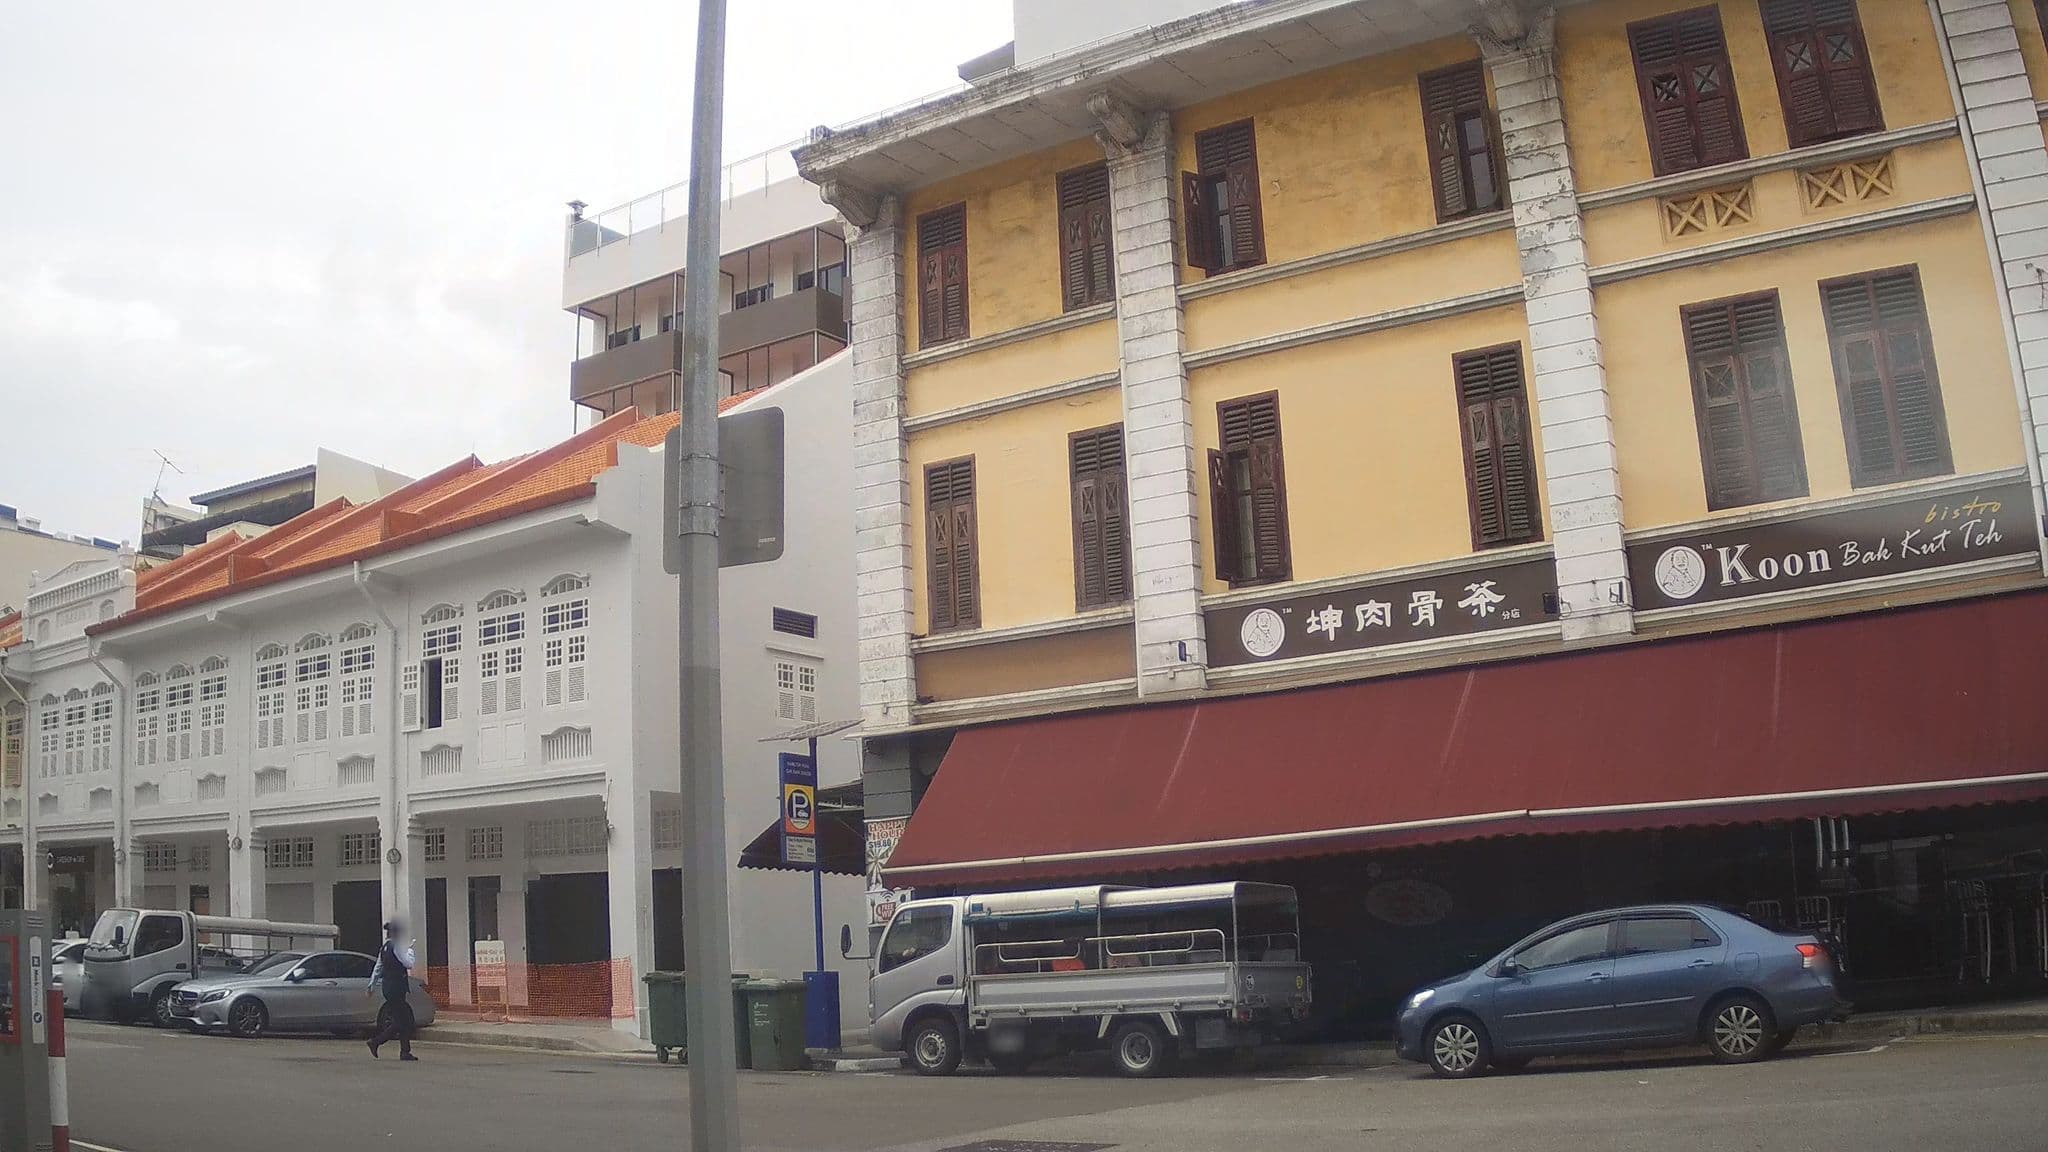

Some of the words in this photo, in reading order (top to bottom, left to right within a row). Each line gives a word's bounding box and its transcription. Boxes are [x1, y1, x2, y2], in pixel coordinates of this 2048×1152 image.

[1924, 496, 2002, 523] bistro
[1716, 543, 1832, 587] Koon
[1838, 538, 1893, 567] Bak
[1900, 529, 1952, 559] Kut
[1959, 518, 2003, 549] Teh
[1306, 580, 1506, 641] 坤肉骨茶
[868, 819, 907, 832] HAPPY
